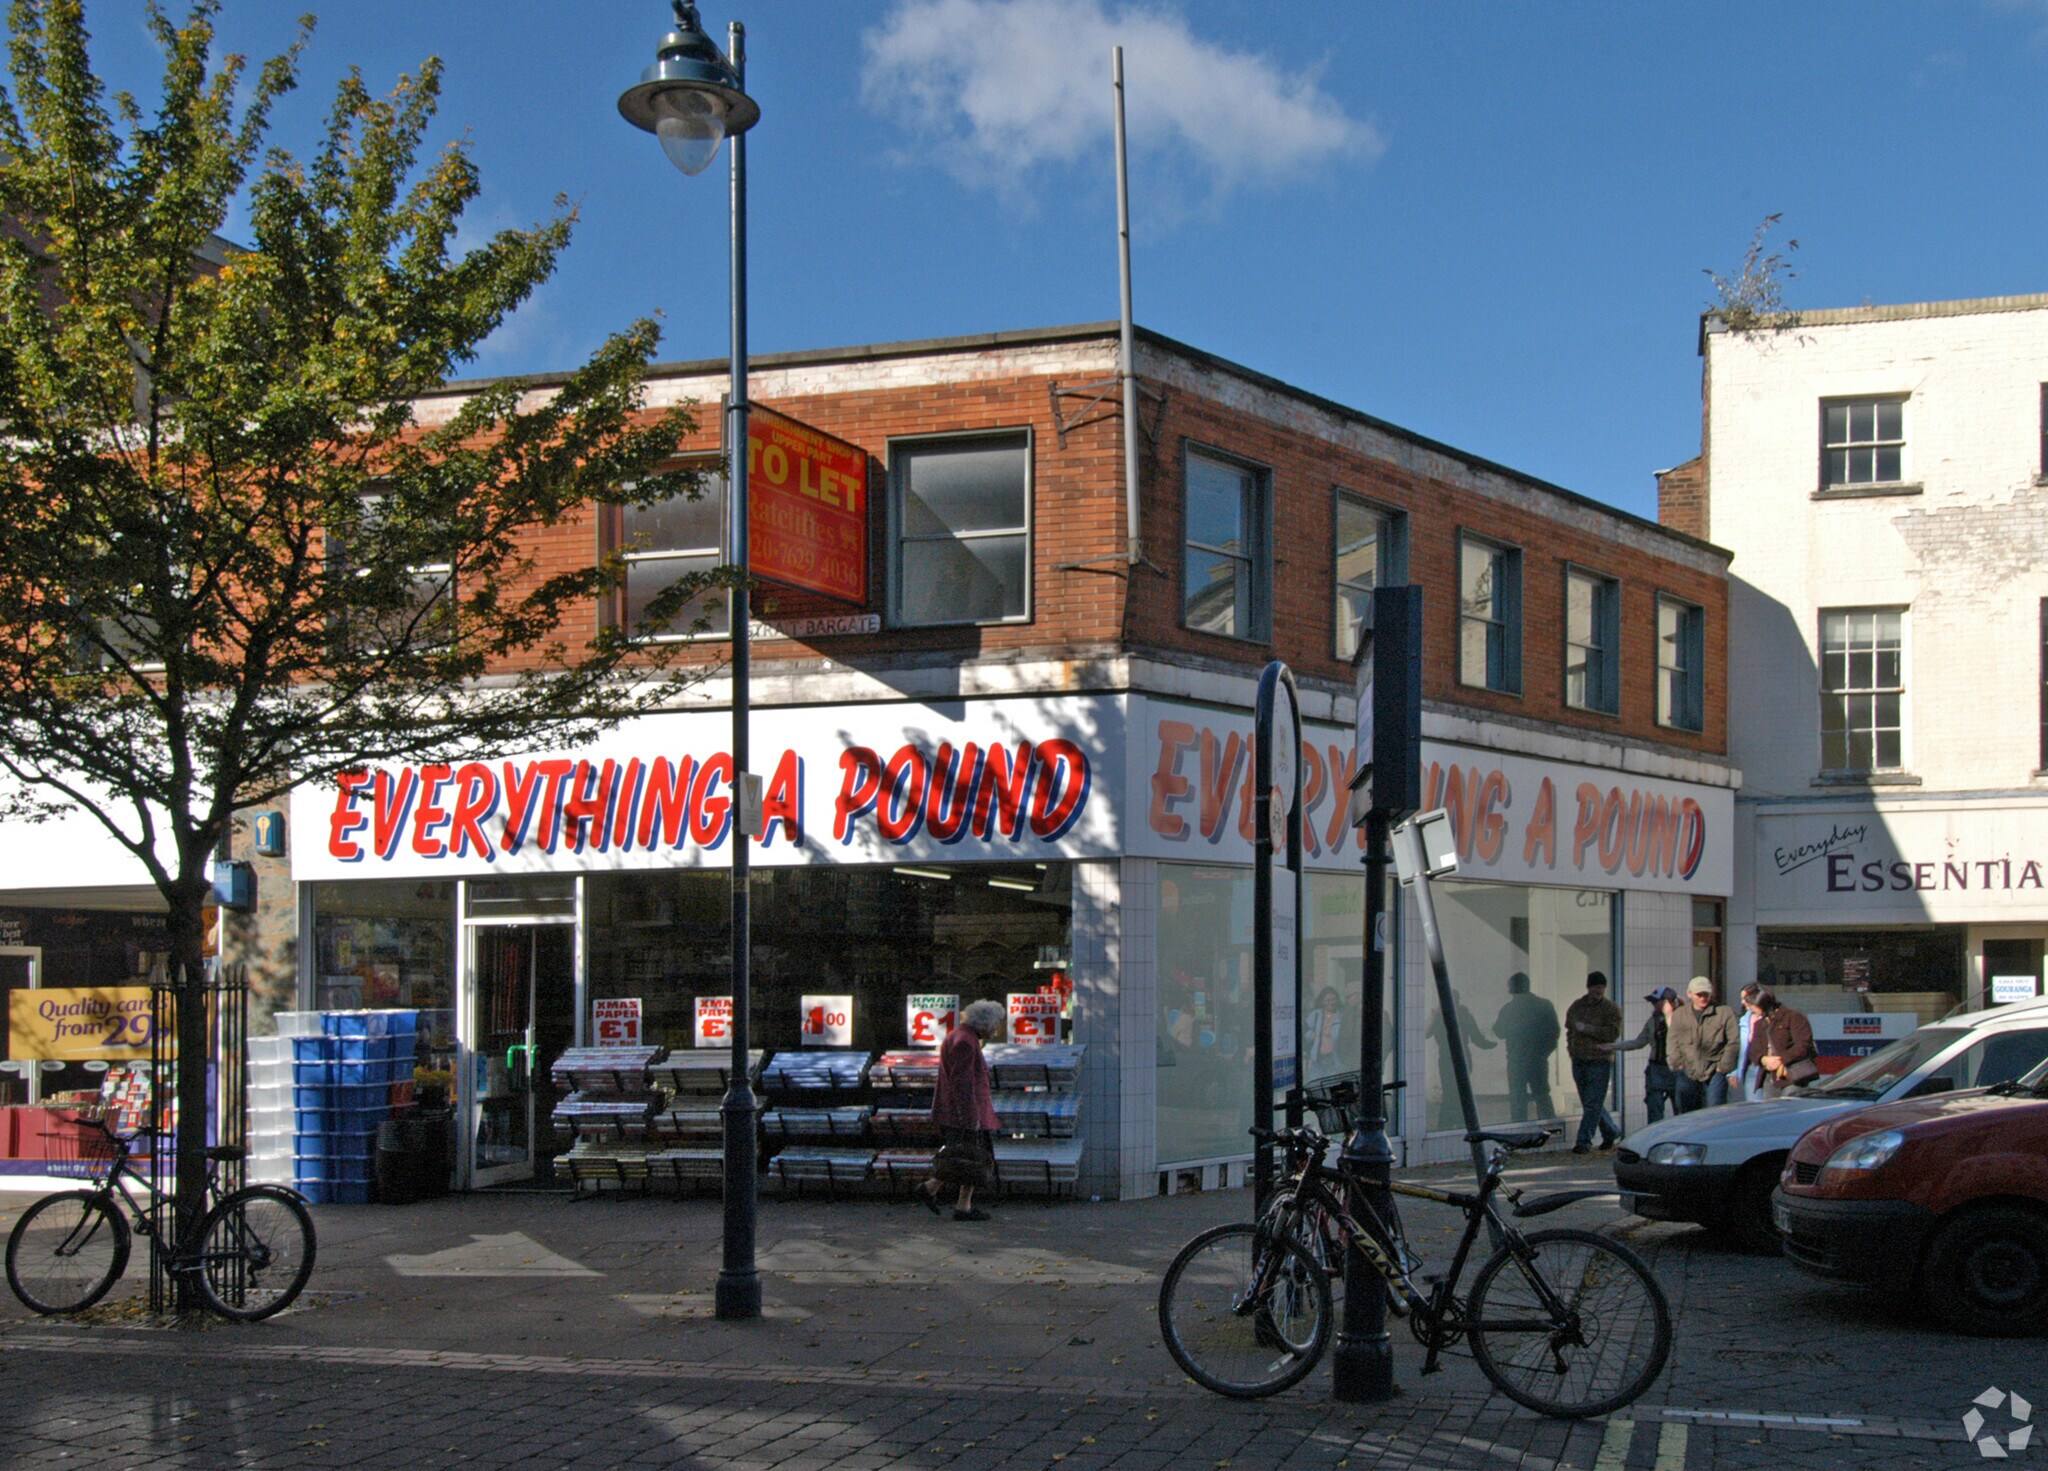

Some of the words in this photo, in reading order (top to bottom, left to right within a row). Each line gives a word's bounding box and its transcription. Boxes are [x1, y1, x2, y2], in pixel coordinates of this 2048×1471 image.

[772, 430, 806, 453] UPPER
[807, 446, 834, 465] PART
[748, 436, 789, 486] TO
[801, 458, 861, 513] LET
[820, 556, 859, 589] 4036
[806, 617, 877, 635] BARGATE
[328, 752, 734, 862] EVERYTHING
[753, 748, 805, 848] A
[832, 737, 1092, 846] POUND
[1149, 719, 1511, 866] EVRYING
[1522, 775, 1556, 870] A
[1573, 782, 1706, 881] POUND
[1774, 823, 1868, 869] Everyday
[1826, 853, 2044, 892] ESSENTIA
[39, 997, 111, 1020] Quality
[597, 1001, 638, 1009] XMAS
[700, 999, 732, 1008] XMA
[1010, 1006, 1058, 1014] PAPER
[1012, 996, 1057, 1005] XMAS
[596, 1009, 639, 1018] PAPER
[698, 1009, 732, 1018] PAPE
[51, 1018, 103, 1043] from
[599, 1020, 637, 1039] £1
[912, 1010, 955, 1042] £1
[1013, 1016, 1056, 1035] £1
[1850, 1046, 1874, 1056] LET
